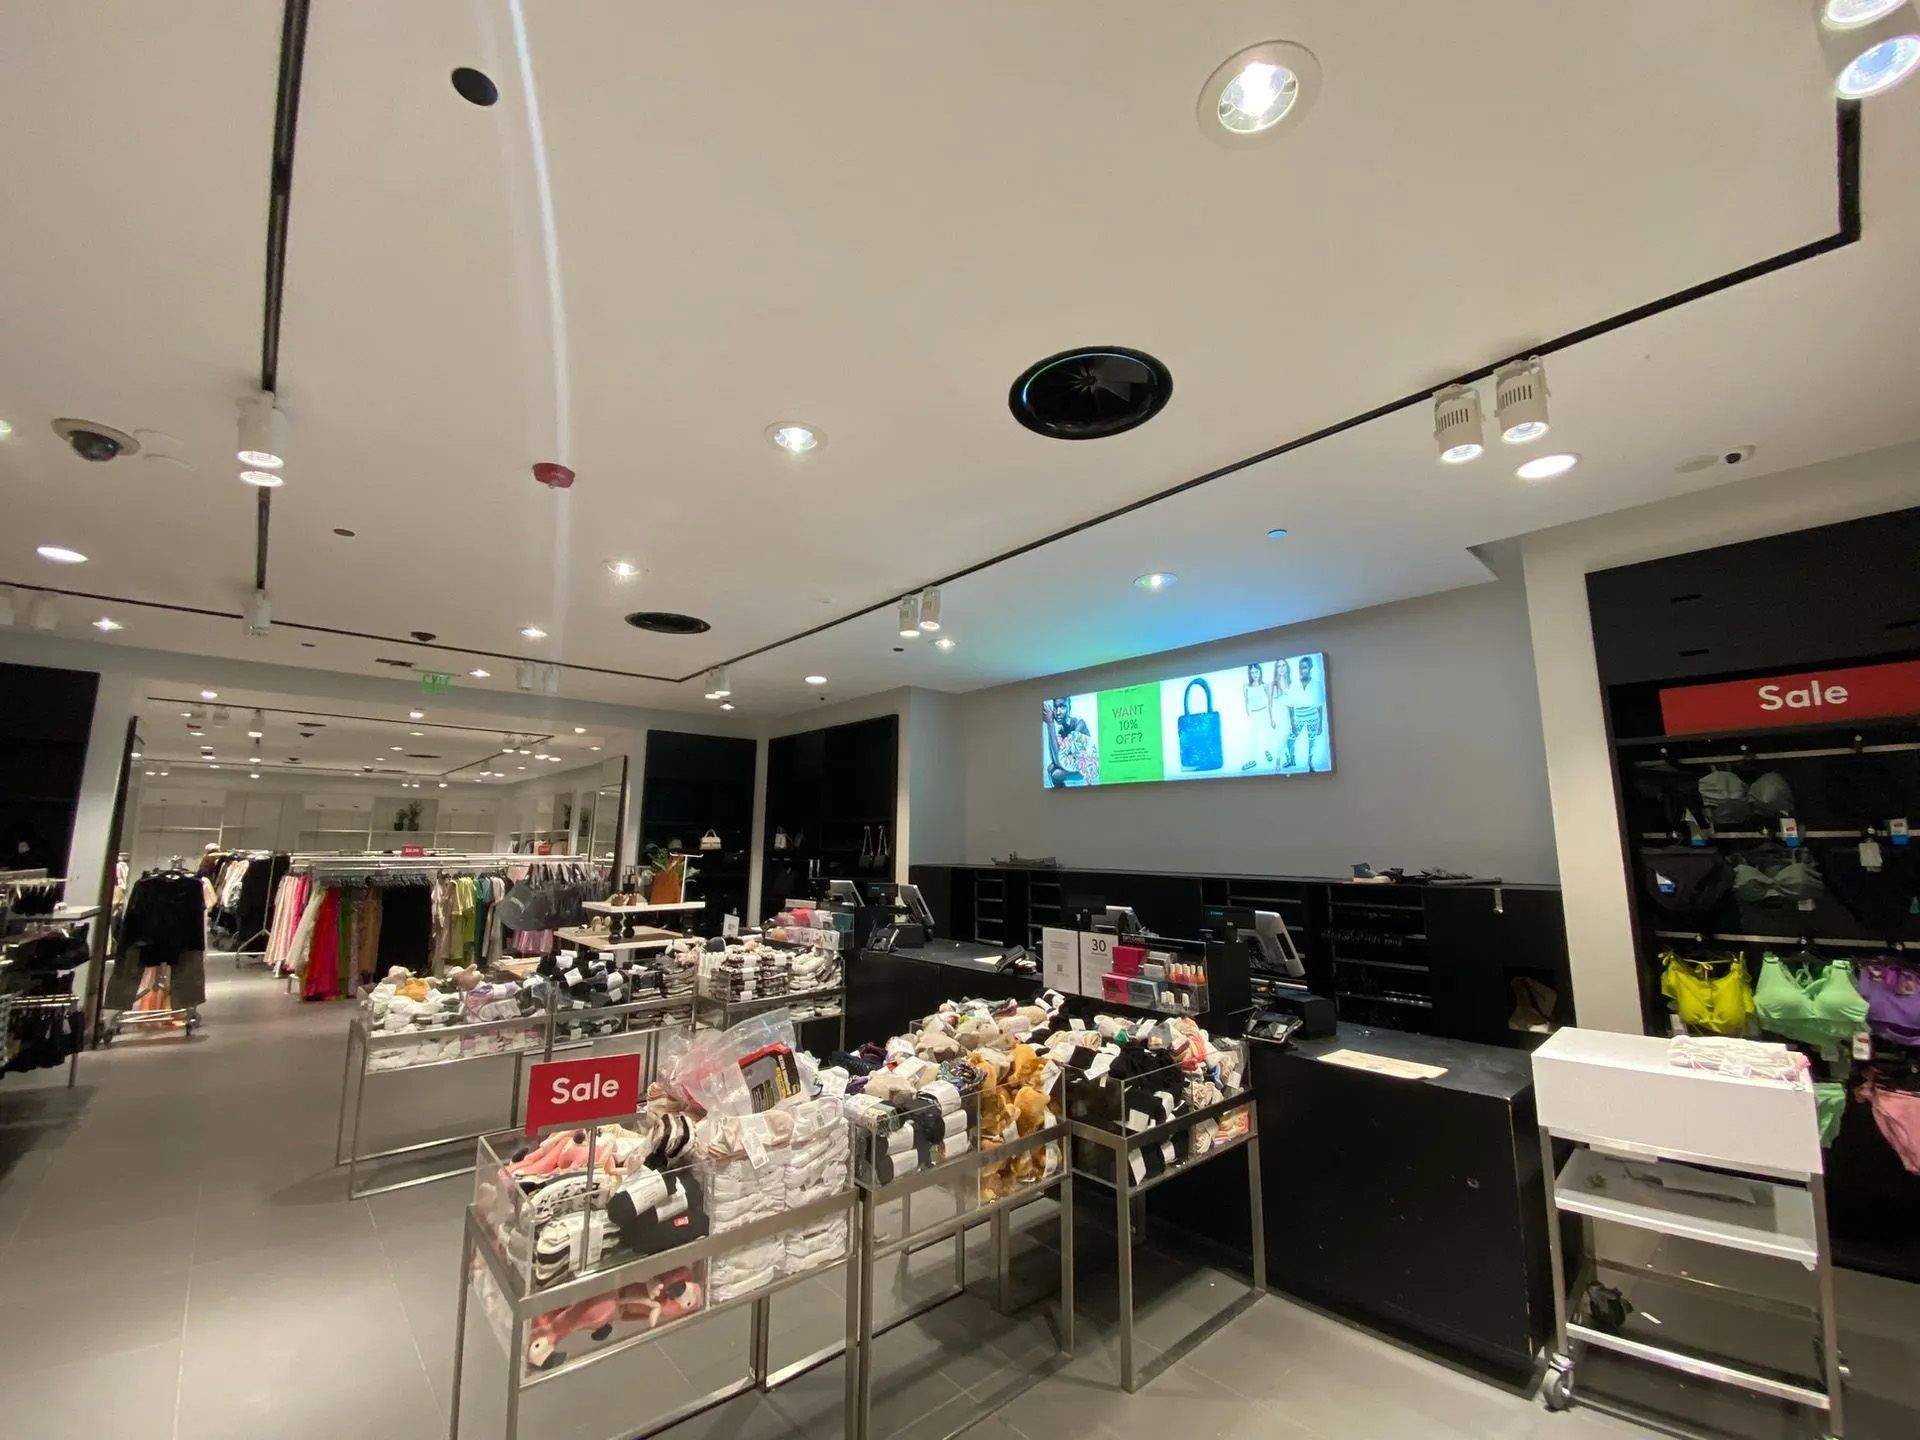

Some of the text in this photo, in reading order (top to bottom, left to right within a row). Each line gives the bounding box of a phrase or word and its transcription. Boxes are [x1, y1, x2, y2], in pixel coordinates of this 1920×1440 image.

[1758, 680, 1848, 711] Sale
[1112, 704, 1144, 719] WANT
[1119, 719, 1138, 731] 10%
[1115, 732, 1142, 744] OFF?
[1091, 939, 1107, 952] 30
[550, 1073, 620, 1105] Sale
